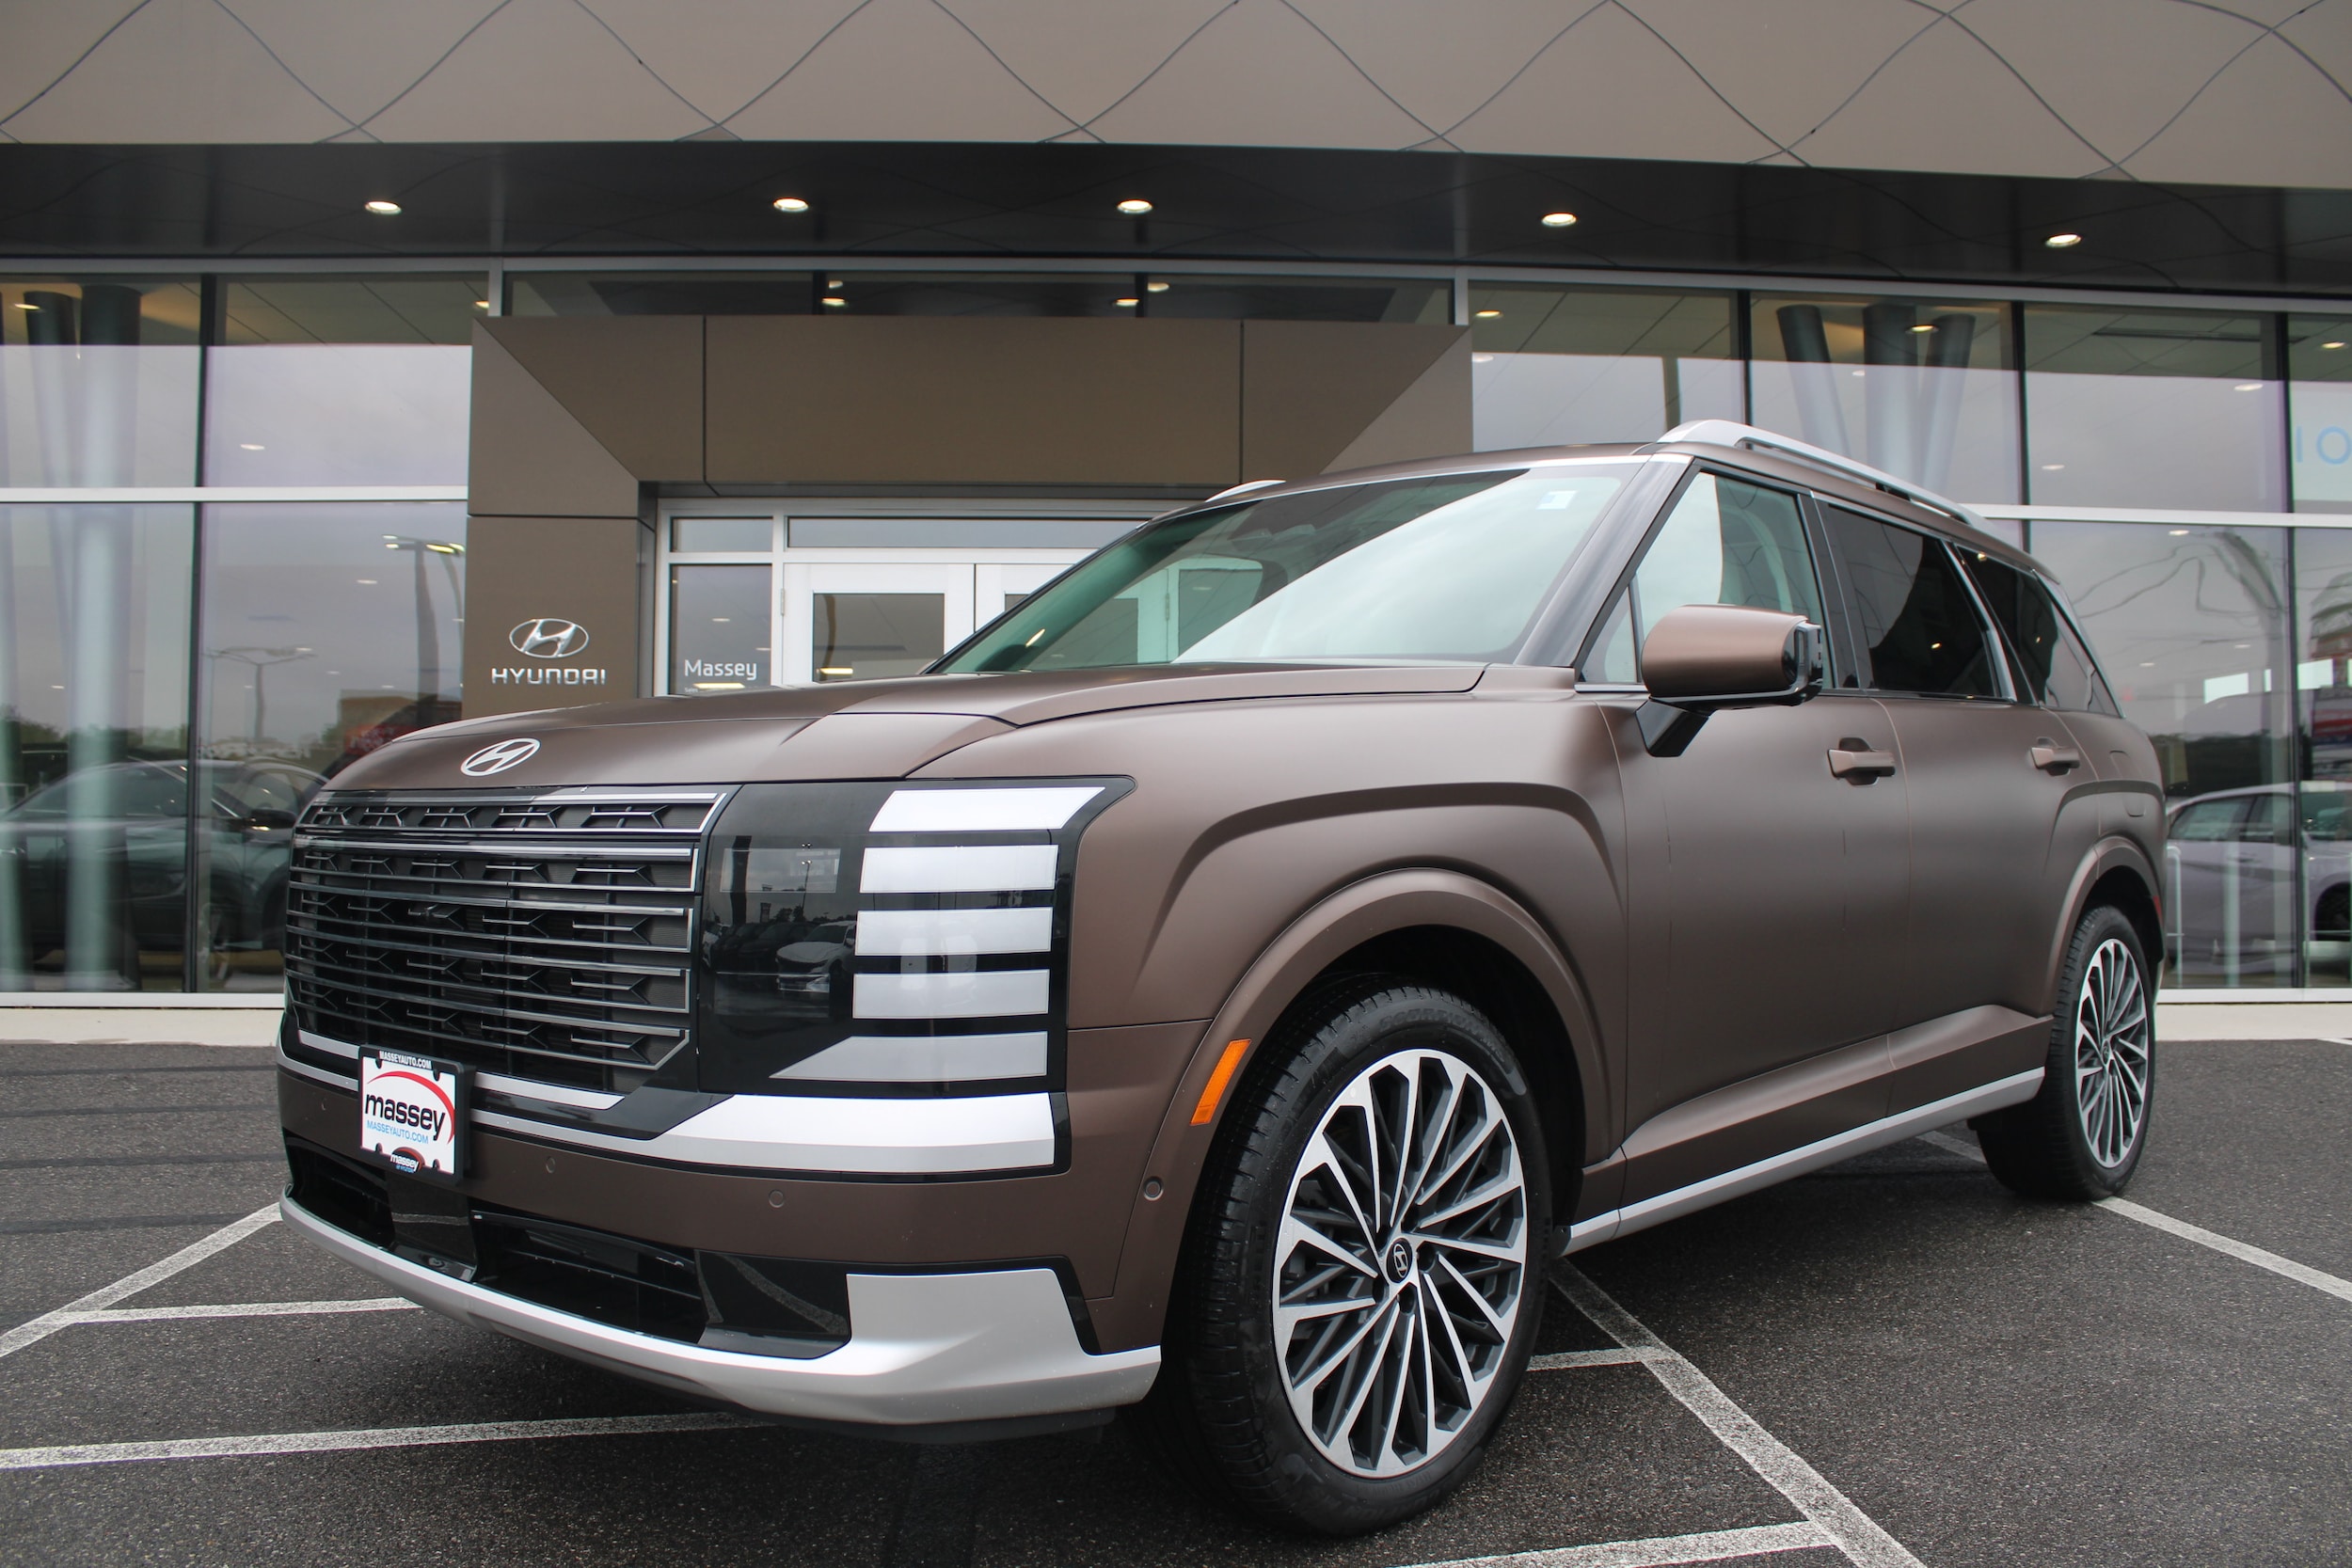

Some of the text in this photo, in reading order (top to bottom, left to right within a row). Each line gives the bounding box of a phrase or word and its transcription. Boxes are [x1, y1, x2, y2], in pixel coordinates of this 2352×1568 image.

[491, 668, 606, 685] HYUNDAI
[684, 659, 756, 680] Massey
[378, 1050, 432, 1069] MASSEYAUTO.COM
[365, 1094, 446, 1141] massey
[366, 1120, 429, 1145] MASSEYAUTO.COM
[389, 1153, 420, 1172] massey
